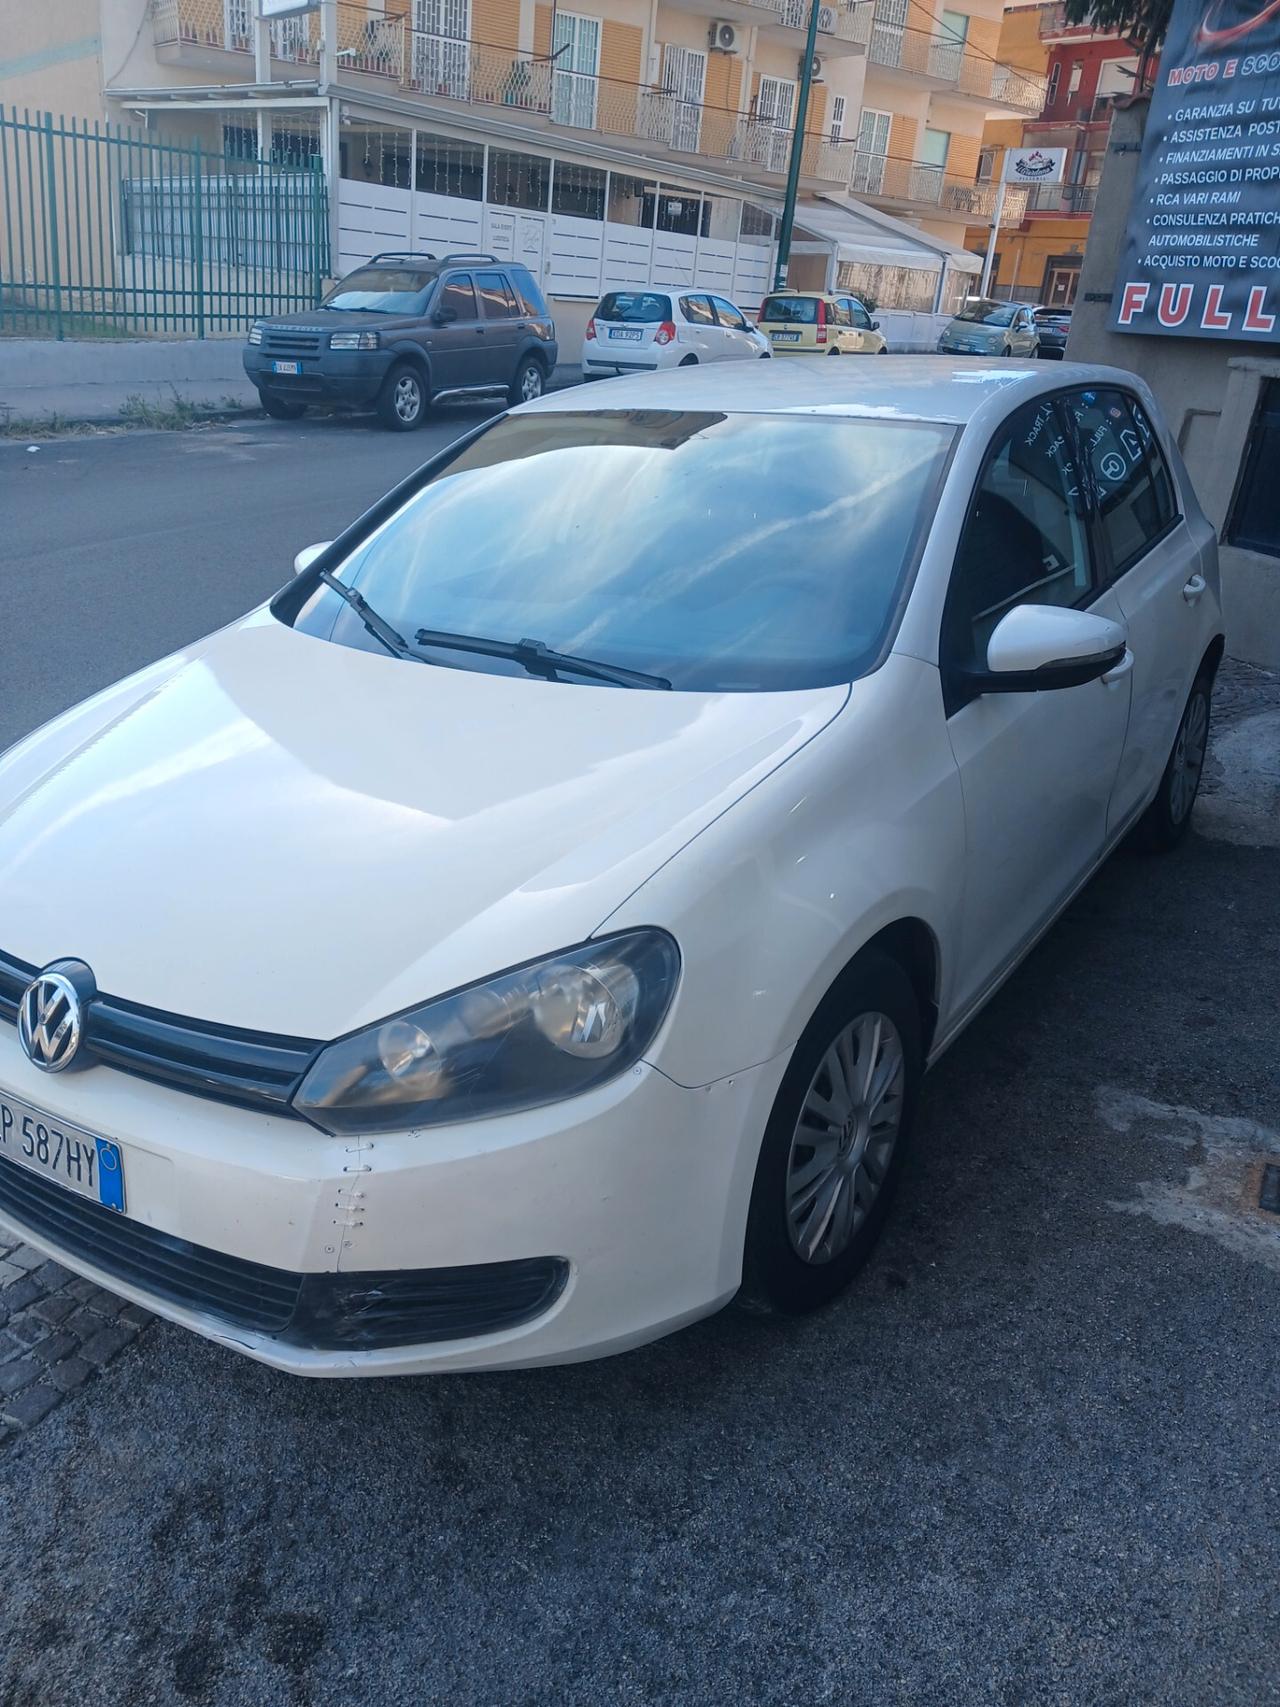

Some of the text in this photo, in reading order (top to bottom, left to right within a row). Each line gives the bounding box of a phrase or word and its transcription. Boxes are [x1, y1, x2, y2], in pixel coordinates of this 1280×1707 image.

[1167, 63, 1219, 86] MOTO
[1223, 58, 1238, 78] E
[1175, 97, 1280, 122] GARANZIA SU TU
[1170, 125, 1242, 143] ASSISTENZA
[1166, 146, 1254, 164] FINANZIAMENTI
[1255, 144, 1270, 158] IN
[1160, 166, 1280, 185] PASSAGGIO DI PROP
[1156, 191, 1241, 206] RCA VARI RAMI
[1153, 211, 1280, 226] CONSULENZA PRATICH
[1148, 233, 1260, 247] AUTOMOBILISTICHE
[1144, 255, 1201, 269] ACQUISTO
[1203, 255, 1236, 268] MOTO
[1239, 255, 1248, 268] E
[1117, 282, 1276, 333] FULL
[22, 1115, 95, 1188] 587HY
